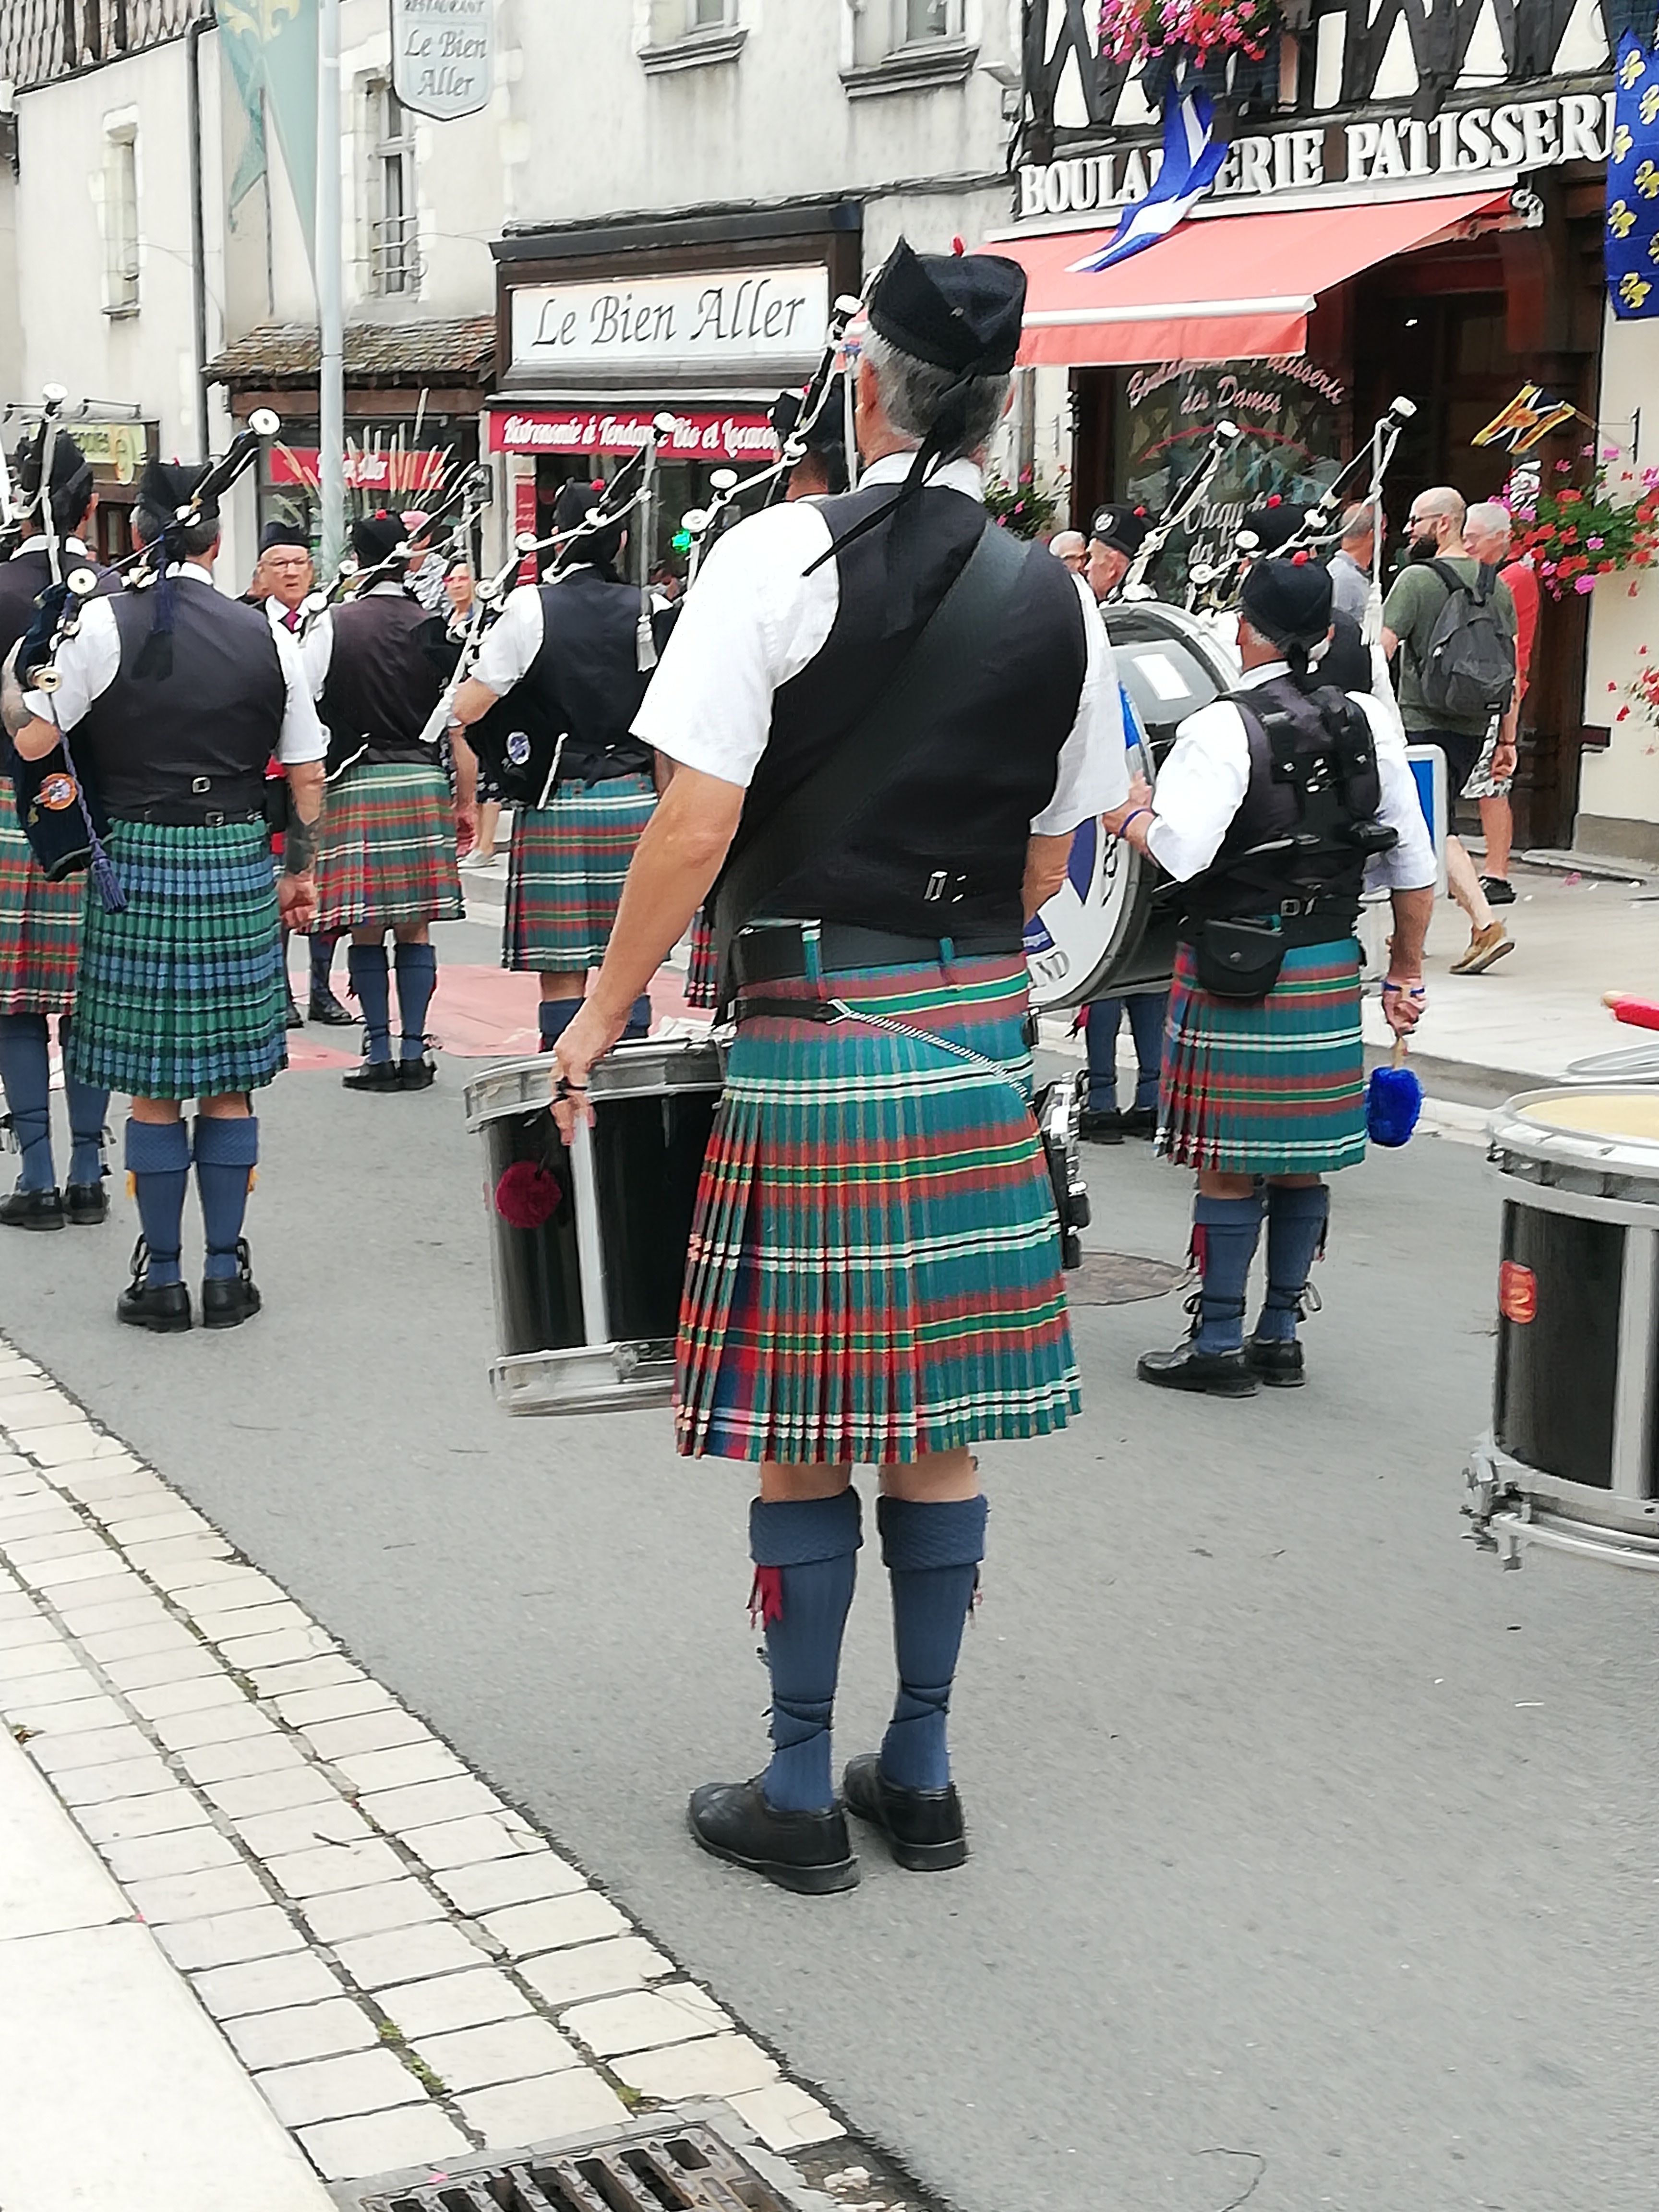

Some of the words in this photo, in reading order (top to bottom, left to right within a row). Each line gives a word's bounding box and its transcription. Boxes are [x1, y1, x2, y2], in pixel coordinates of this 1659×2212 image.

[404, 29, 432, 57] Le
[438, 29, 487, 59] Bien
[418, 66, 474, 96] Aller
[1018, 128, 1324, 216] BOULAERIE
[532, 299, 577, 347] Le
[590, 293, 676, 346] Bien
[689, 278, 805, 341] Aller
[1217, 374, 1282, 415] Dames
[581, 415, 597, 445] à
[598, 416, 669, 447] Tendane
